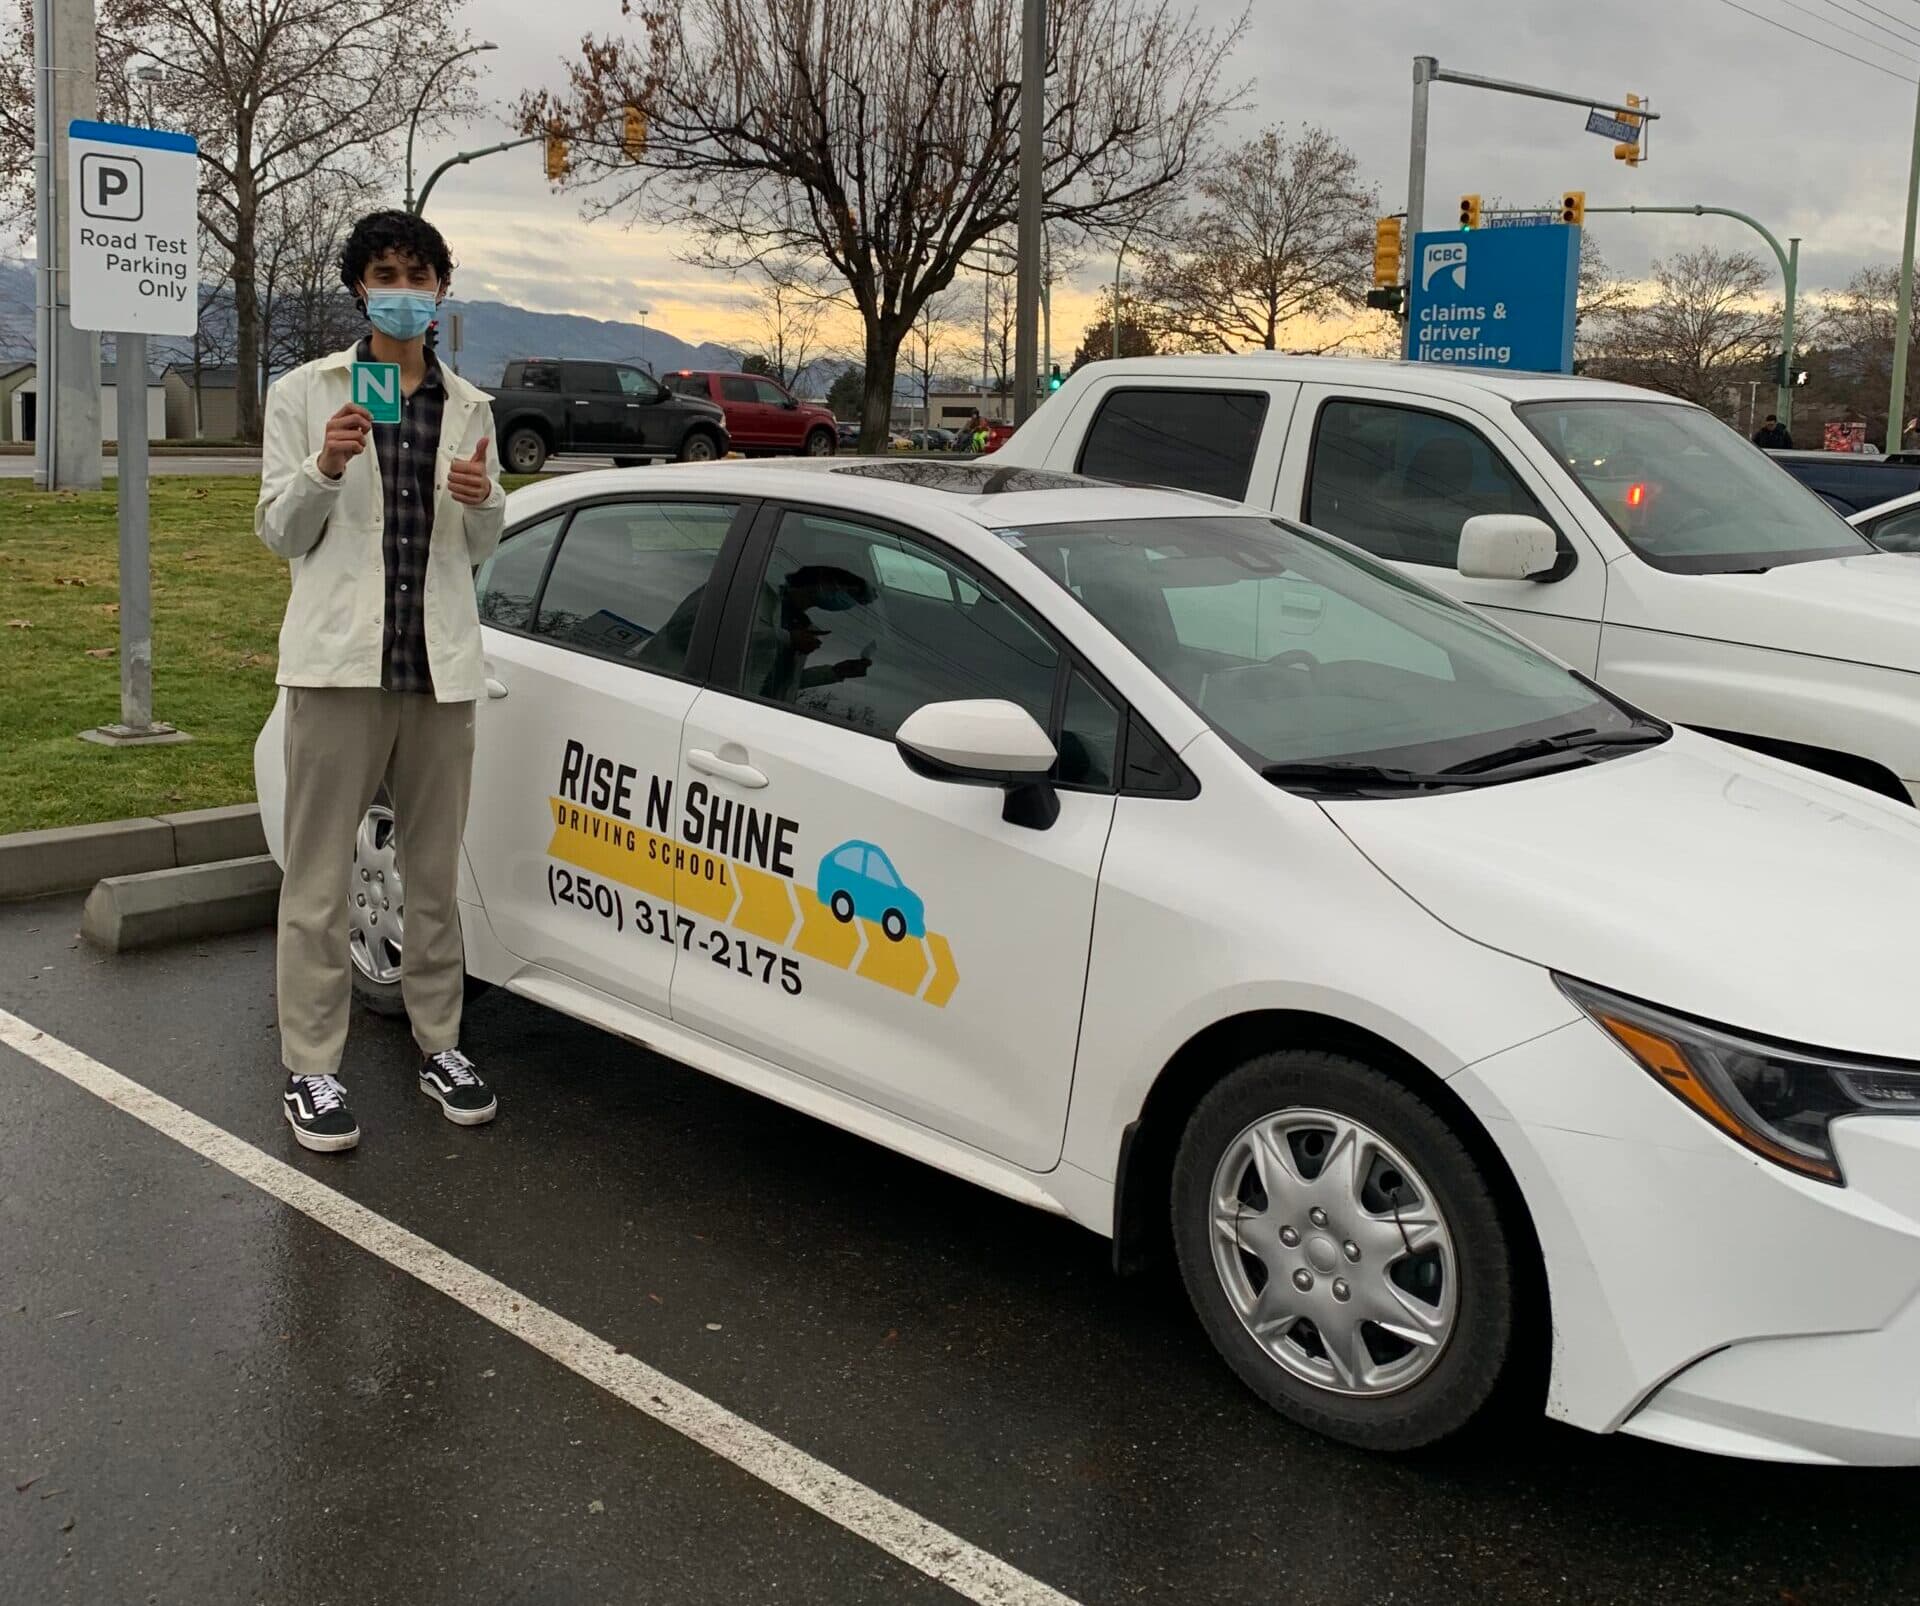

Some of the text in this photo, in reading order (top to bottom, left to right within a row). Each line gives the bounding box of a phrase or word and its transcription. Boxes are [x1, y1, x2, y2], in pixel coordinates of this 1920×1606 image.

[98, 167, 128, 206] P
[1492, 217, 1536, 228] DAYTON
[81, 228, 187, 254] Road Test
[106, 253, 187, 279] Parking
[1428, 248, 1463, 262] ICBC
[138, 279, 187, 301] Only
[1420, 302, 1507, 321] claims &
[1419, 324, 1480, 341] driver
[1418, 343, 1511, 363] licensing
[357, 367, 394, 404] N
[559, 739, 799, 878] RISE N SHINE
[557, 804, 727, 886] DRIVING SCHOOL
[548, 864, 803, 996] (250) 317-2175
